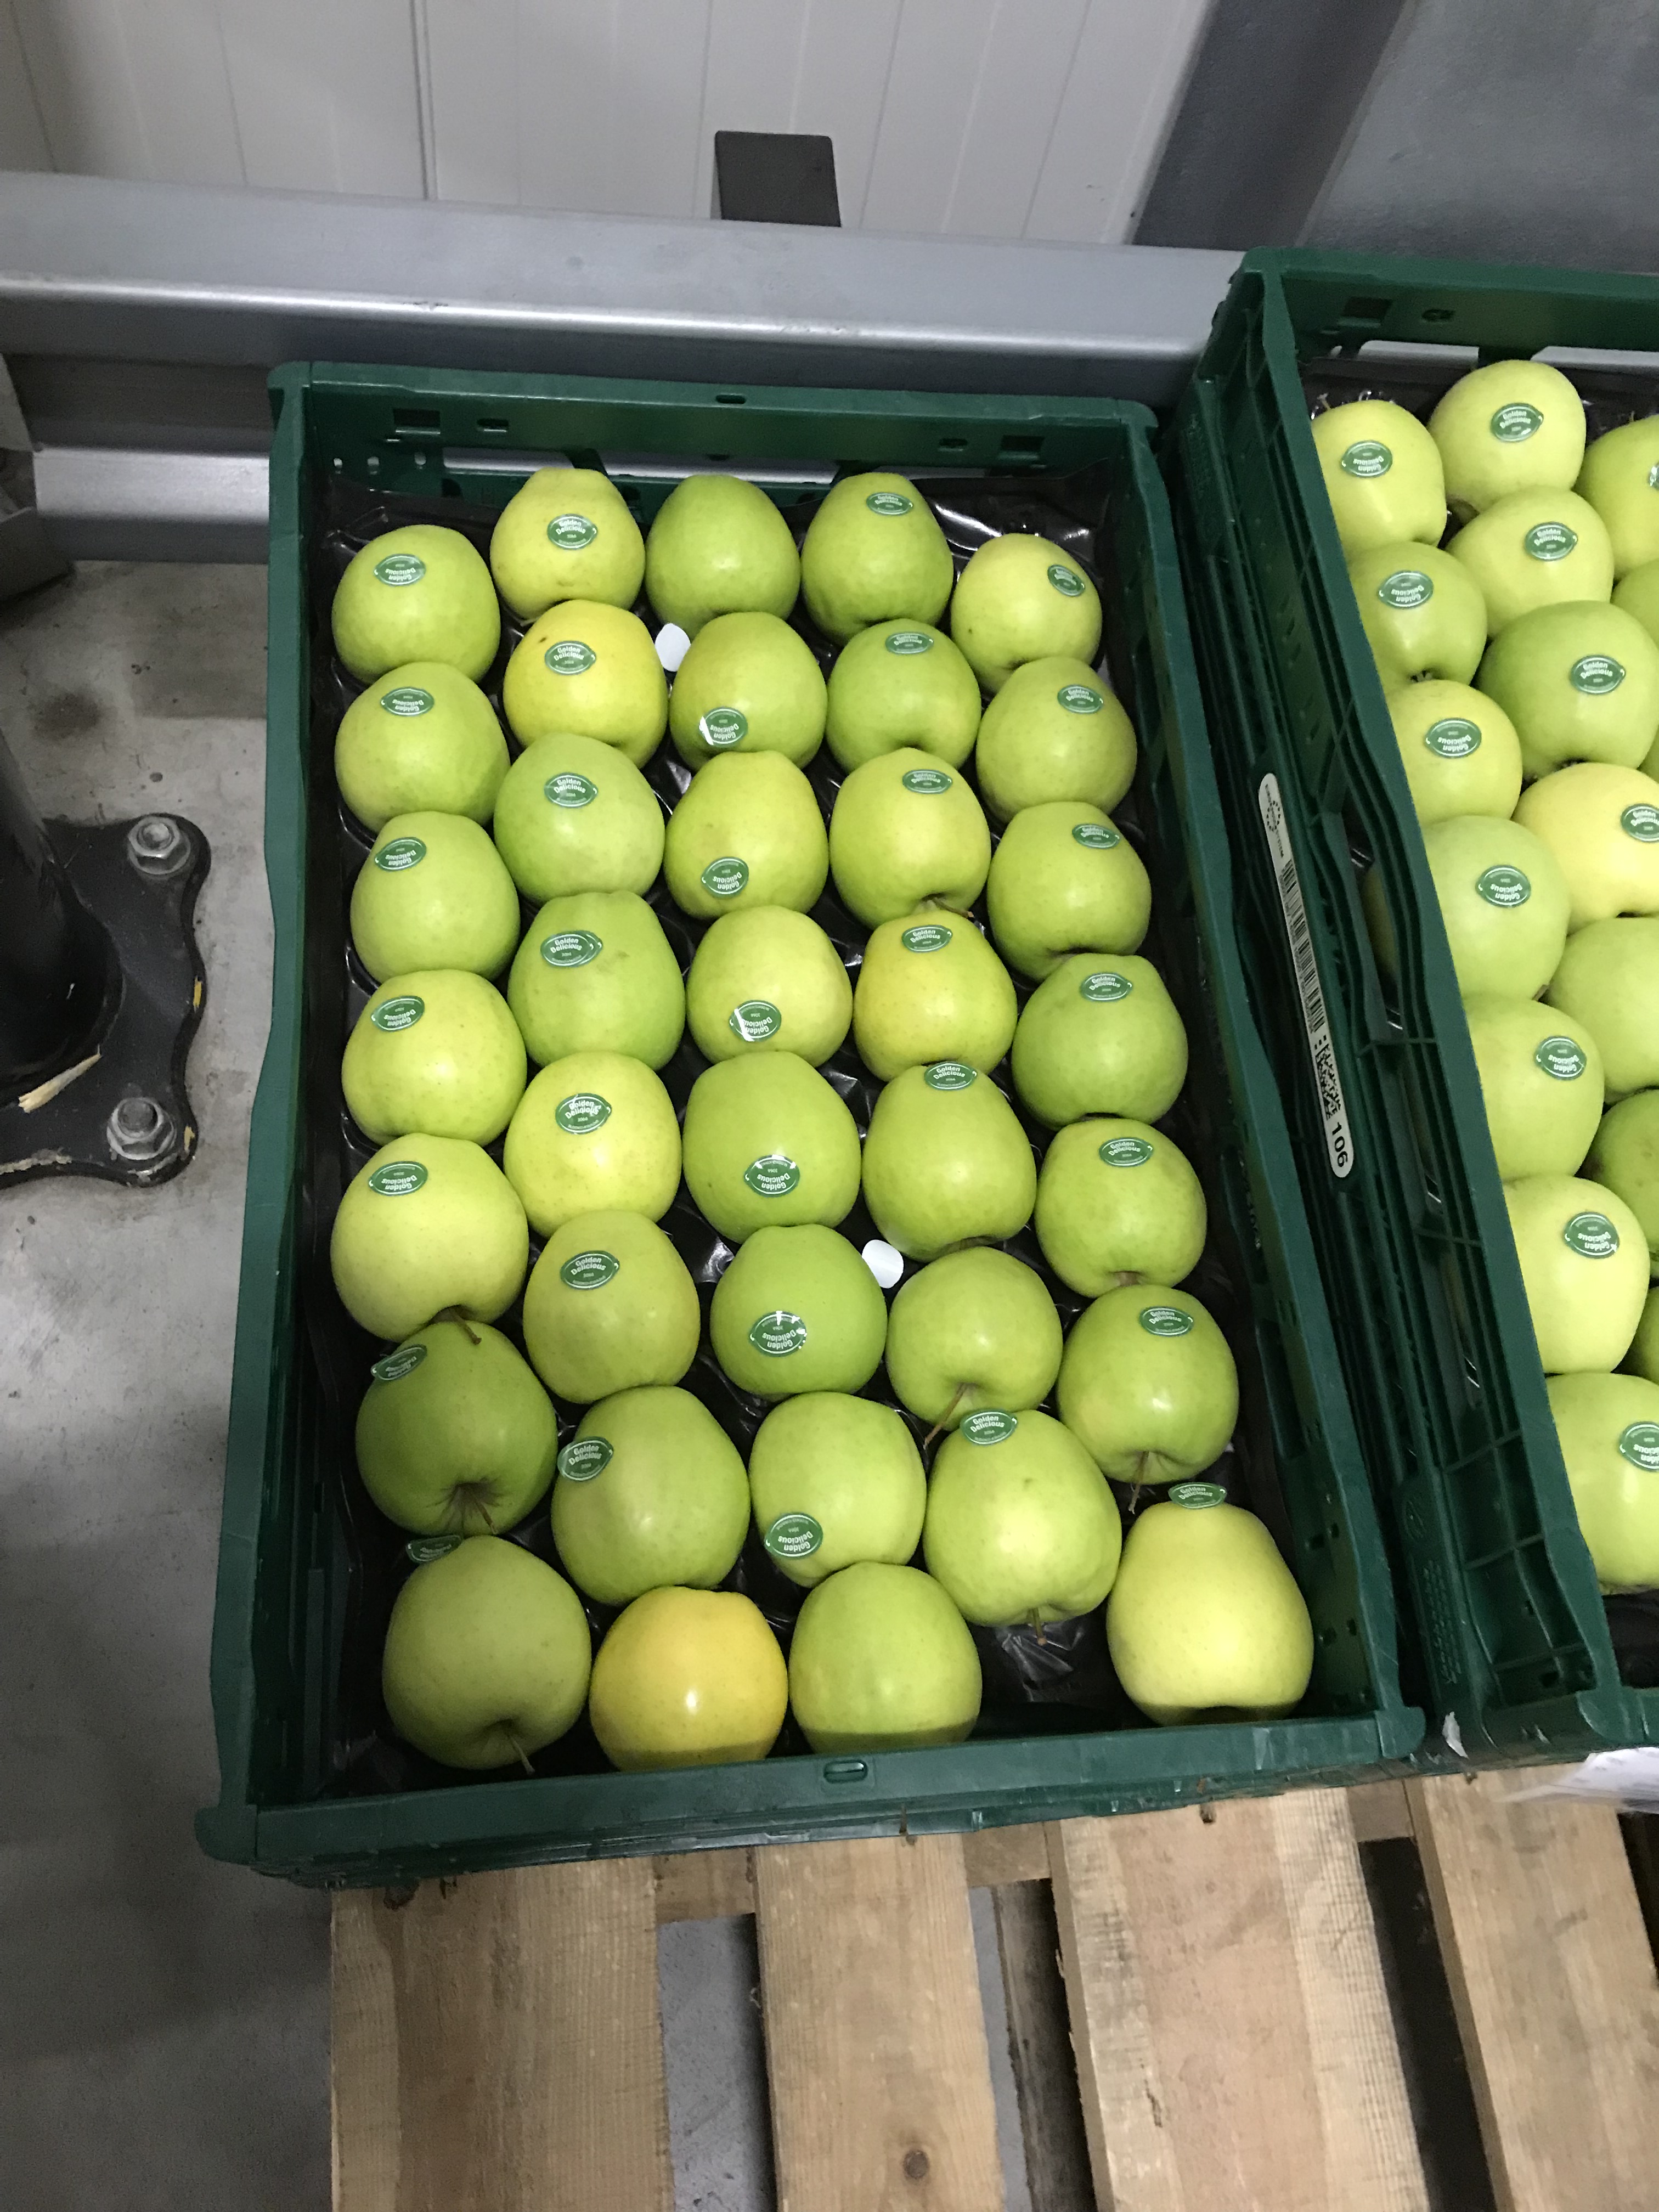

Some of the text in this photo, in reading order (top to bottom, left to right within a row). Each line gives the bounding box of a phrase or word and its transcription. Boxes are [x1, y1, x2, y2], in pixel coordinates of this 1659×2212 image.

[555, 526, 586, 534] Delicious
[554, 653, 584, 661] Delicious
[1438, 735, 1471, 744] Delicious
[554, 785, 586, 793] Delicious
[713, 873, 742, 882] Delicious
[1491, 884, 1522, 893] Delicious
[1495, 893, 1520, 901] Golden
[910, 934, 940, 943] Delicious
[550, 944, 583, 953] Delicious
[1089, 982, 1120, 990] Delicious
[1548, 1054, 1579, 1064] Delicious
[1554, 1064, 1577, 1073] Golden
[569, 1101, 594, 1110] Golden
[1332, 1122, 1348, 1167] 106
[1108, 1147, 1141, 1156] Delicious
[381, 1177, 417, 1186] Delicious
[757, 1173, 790, 1182] Delicious
[1578, 1232, 1611, 1242] Delicious
[1584, 1242, 1610, 1251] Golden
[575, 1257, 602, 1266] Golden
[571, 1264, 606, 1275] Delicious
[762, 1330, 797, 1341] Delicious
[767, 1340, 793, 1349] Golden
[973, 1415, 999, 1425] Golden
[970, 1421, 1005, 1433] Delicious
[573, 1445, 599, 1455] Golden
[568, 1452, 602, 1465] Delicious
[778, 1532, 813, 1544] Delicious
[783, 1542, 810, 1551] Golden
